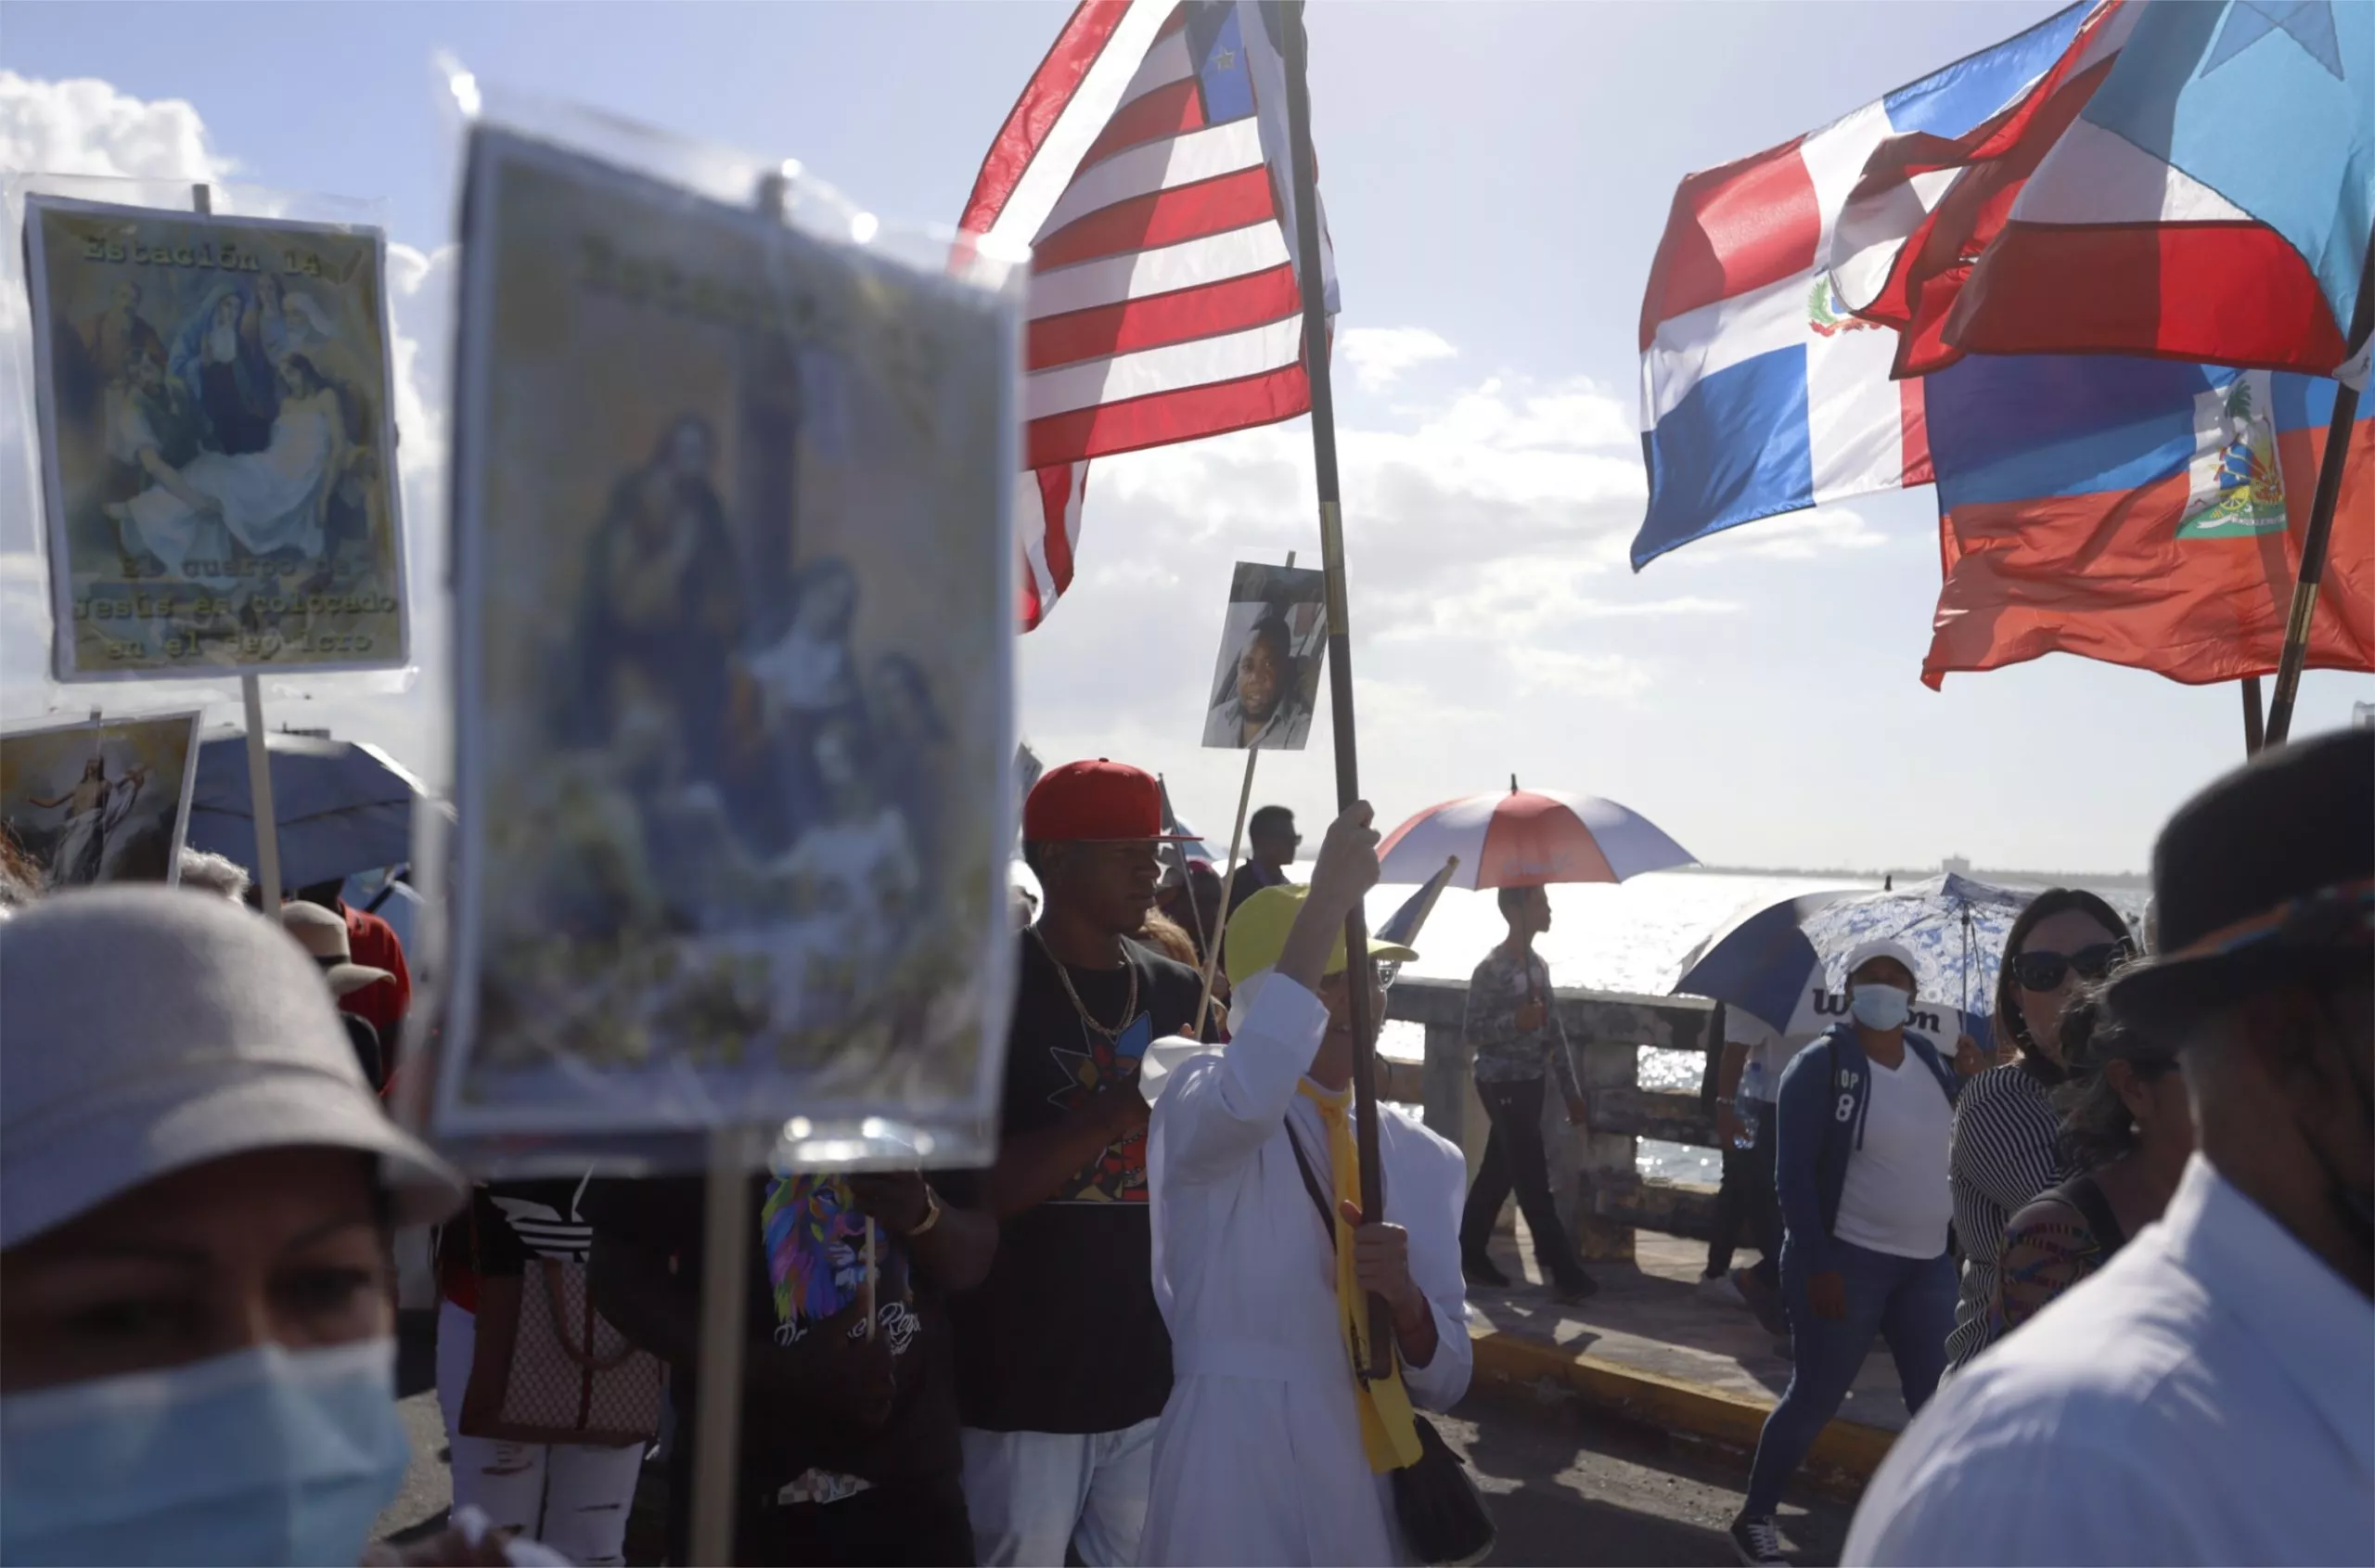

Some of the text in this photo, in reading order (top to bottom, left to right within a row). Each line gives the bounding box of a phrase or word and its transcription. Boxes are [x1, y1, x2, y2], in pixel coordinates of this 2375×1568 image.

[83, 238, 260, 272] Estación
[252, 592, 398, 615] colocado
[165, 632, 203, 659] el
[228, 631, 372, 660] seplcro
[1840, 1069, 1859, 1090] OP
[1835, 1093, 1855, 1123] 8
